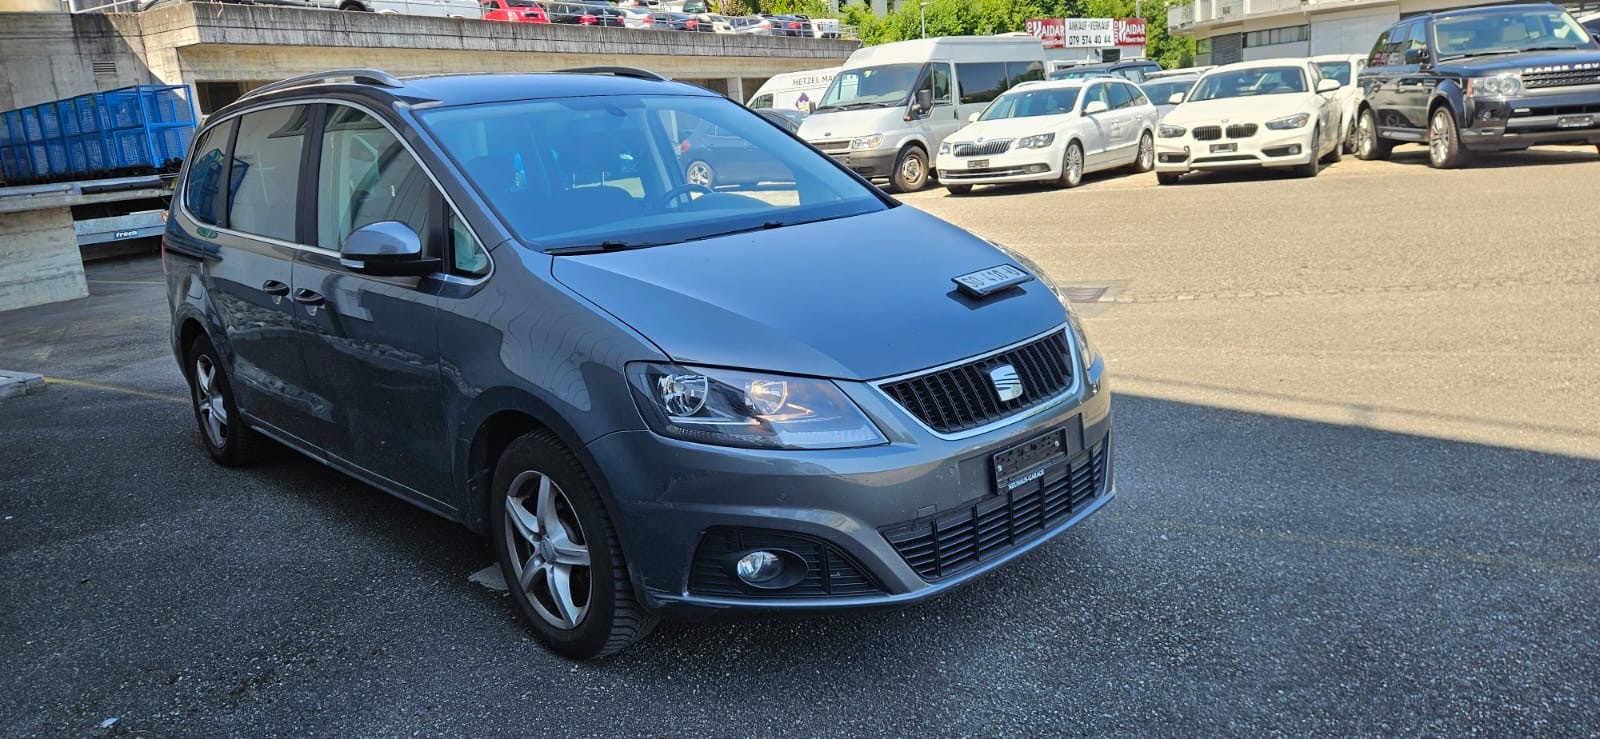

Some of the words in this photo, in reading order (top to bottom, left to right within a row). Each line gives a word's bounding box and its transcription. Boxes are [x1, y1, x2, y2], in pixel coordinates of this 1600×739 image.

[1068, 35, 1079, 45] 079
[1081, 34, 1092, 44] 574
[1093, 34, 1101, 44] 40
[1103, 33, 1111, 43] 44
[1525, 64, 1569, 74] RANGE
[792, 76, 820, 86] HETZEL
